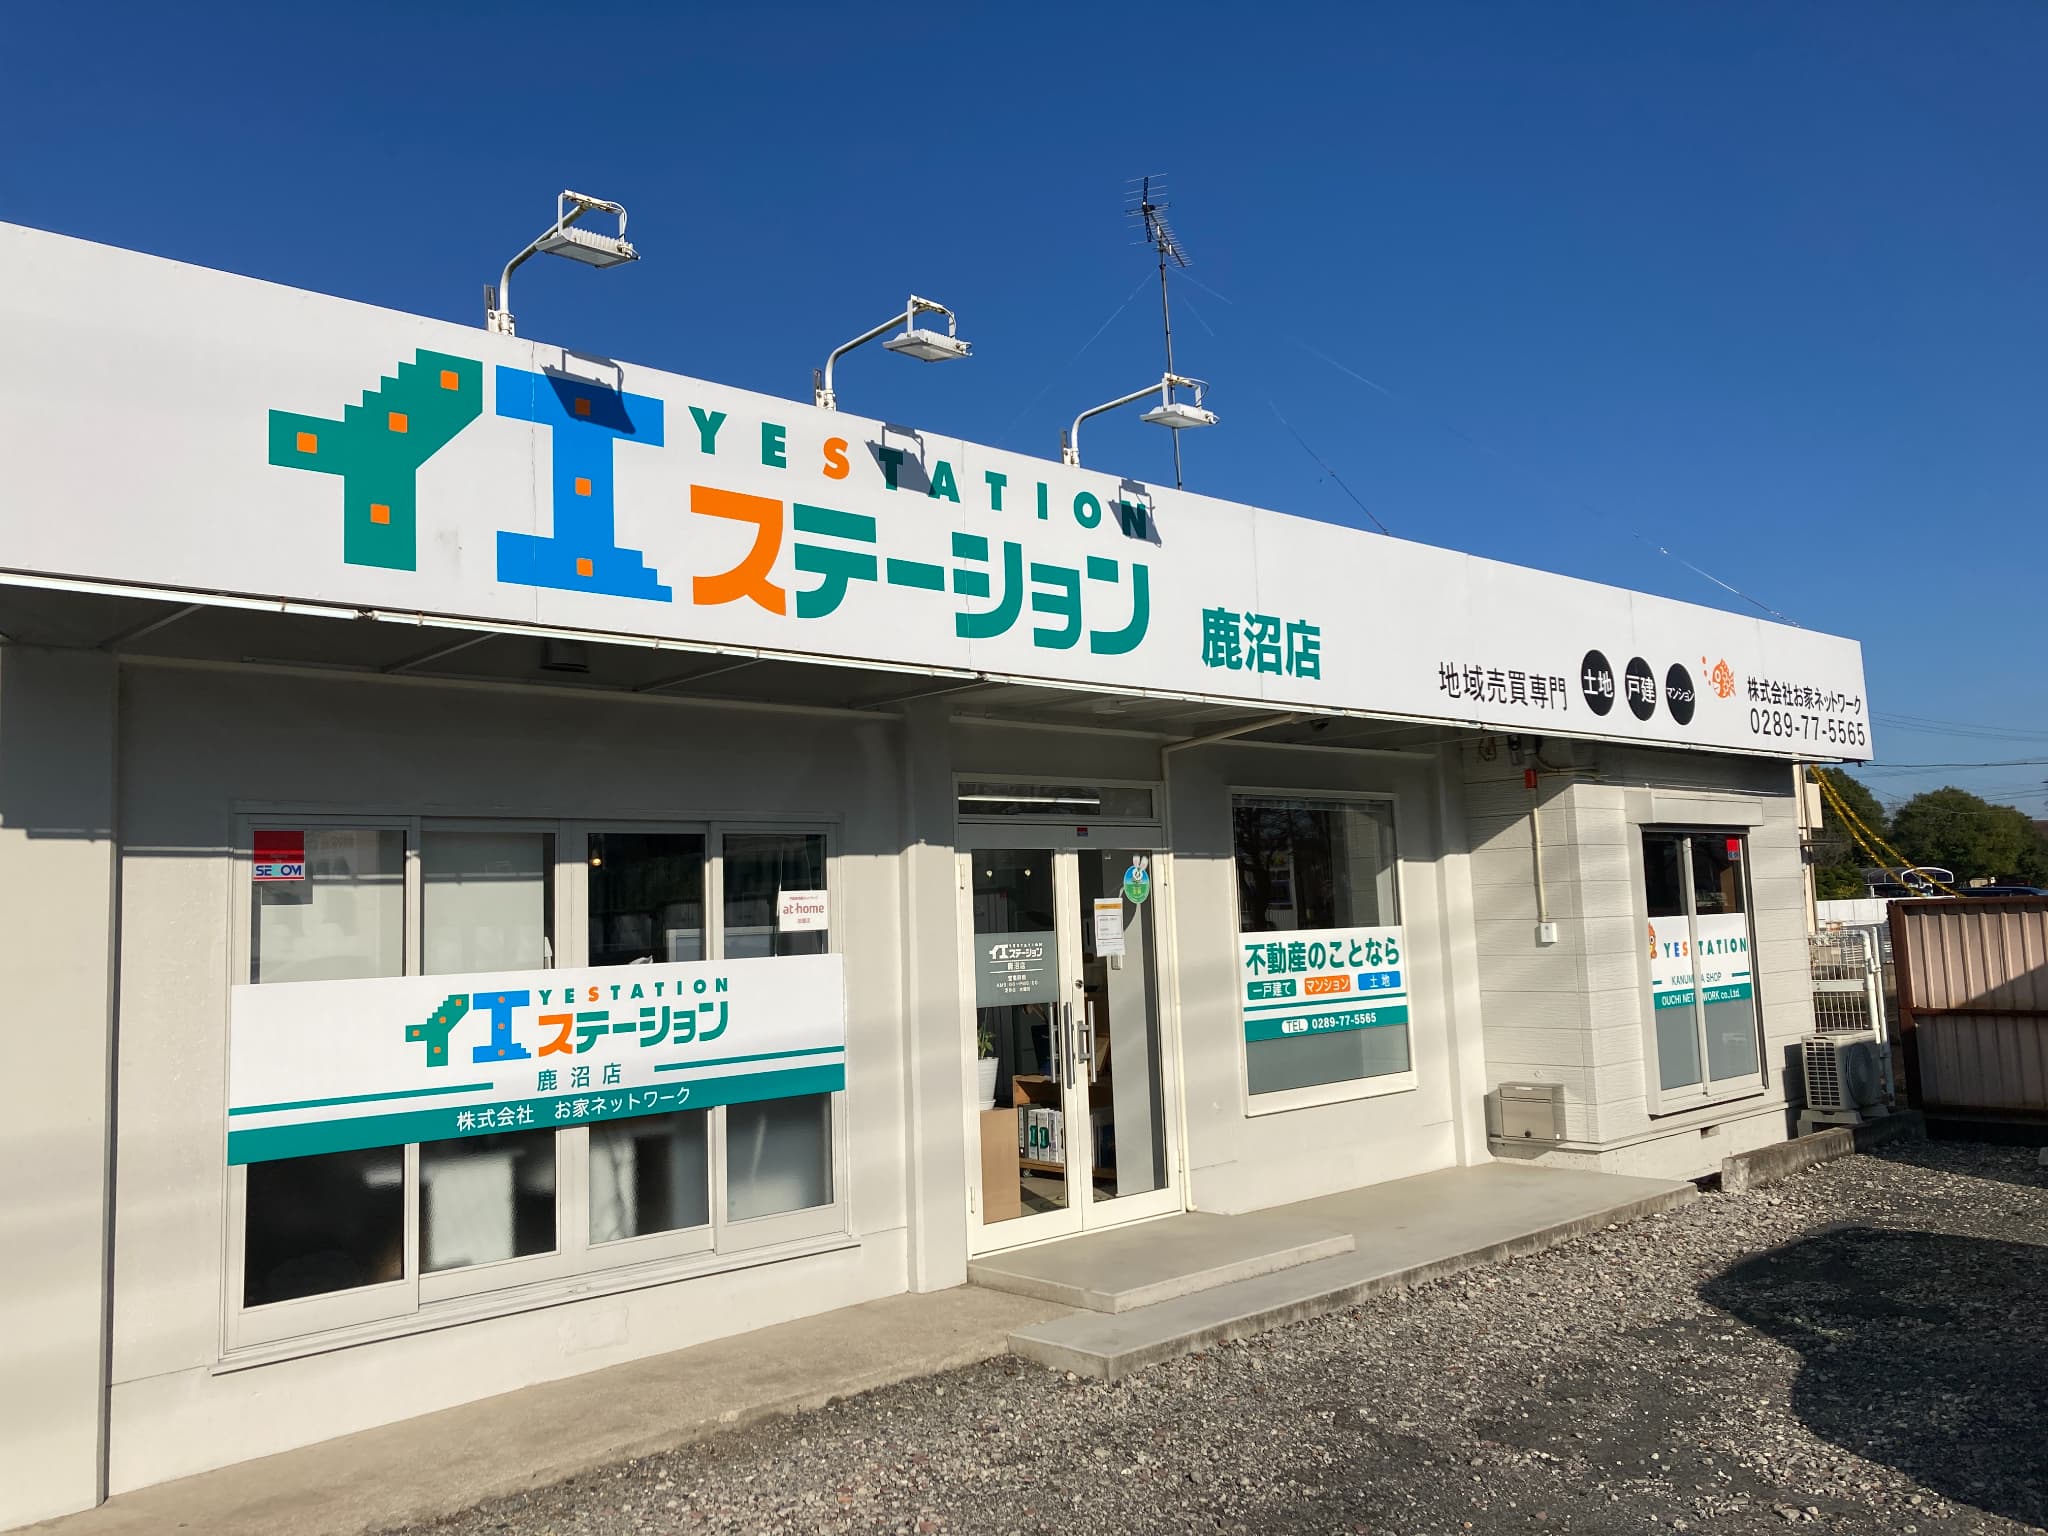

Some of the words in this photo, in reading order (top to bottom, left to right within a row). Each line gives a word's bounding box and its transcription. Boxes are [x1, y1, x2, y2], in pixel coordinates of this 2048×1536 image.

[688, 406, 1147, 540] YESTATION
[1201, 607, 1321, 681] 鹿沼店
[1438, 661, 1568, 711] 地域売買専門
[1583, 669, 1614, 698] 土地
[1625, 673, 1657, 704] 戸建
[1665, 687, 1695, 702] マンション
[1747, 676, 1862, 715] 株式会社お家ネットワーク
[1750, 708, 1866, 746] 0289-77-5565
[1245, 937, 1400, 976] 不動産のことなら
[539, 978, 728, 1005] YESTATION
[1252, 982, 1291, 998] 一戸建て
[1305, 978, 1350, 993] マンション
[1370, 975, 1391, 988] 土地
[1706, 972, 1722, 982] SHOP
[1662, 994, 1682, 1006] OUCHI
[405, 989, 728, 1067] イエステーション
[1287, 1020, 1304, 1033] TEL
[1312, 1012, 1377, 1029] 0289-77-5565
[537, 1063, 621, 1092] 鹿沼店
[456, 1104, 534, 1132] 株式会社
[554, 1086, 691, 1120] お家ネットワーク
